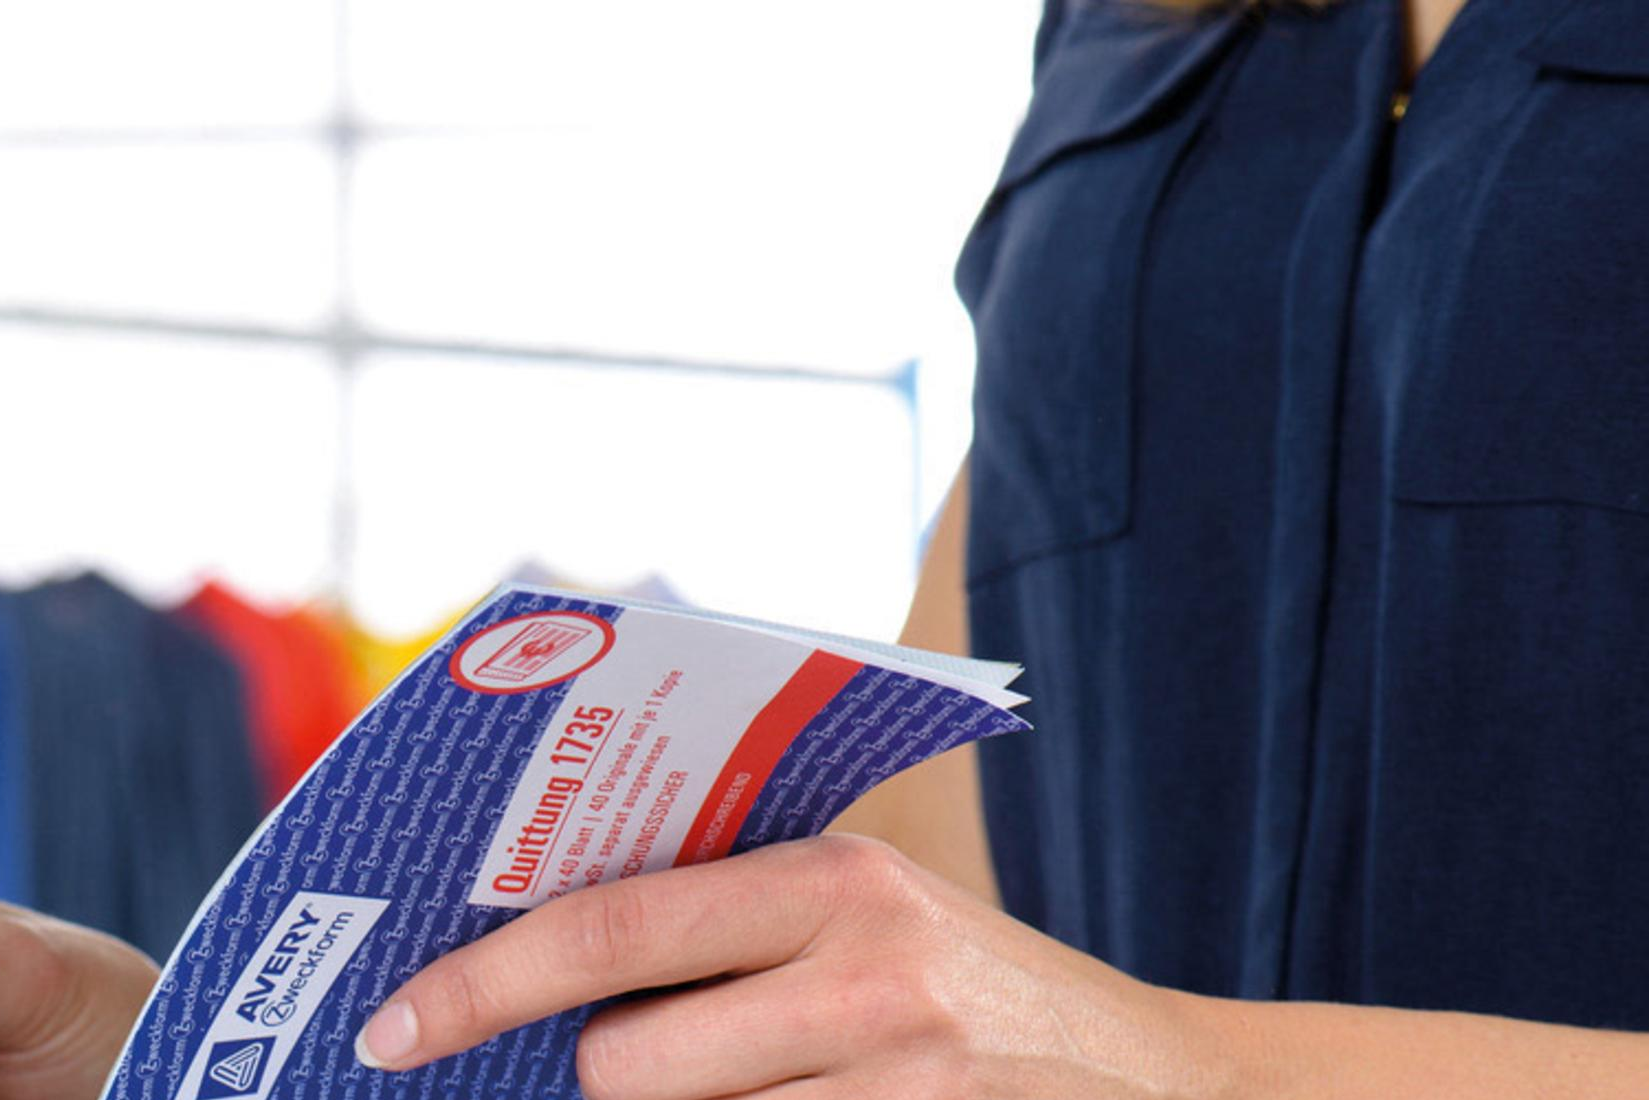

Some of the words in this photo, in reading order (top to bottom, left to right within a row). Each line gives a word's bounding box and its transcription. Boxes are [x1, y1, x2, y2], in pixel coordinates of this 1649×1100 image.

[651, 669, 684, 698] Kopie
[629, 722, 651, 741] mit
[492, 776, 584, 893] Quittung
[550, 705, 614, 765] 1735
[597, 742, 638, 792] Originale
[584, 861, 608, 886] wSt.
[598, 811, 631, 856] separat
[622, 735, 672, 809] ausgewiesen
[589, 794, 610, 812] 40
[619, 770, 689, 879] SCHUNGSSICHER
[694, 772, 752, 861] RCHSCHREIBEND
[559, 859, 580, 877] 40
[568, 827, 595, 857] Blatt
[236, 908, 321, 1023] AVERY
[261, 911, 355, 1027] Zweckform
